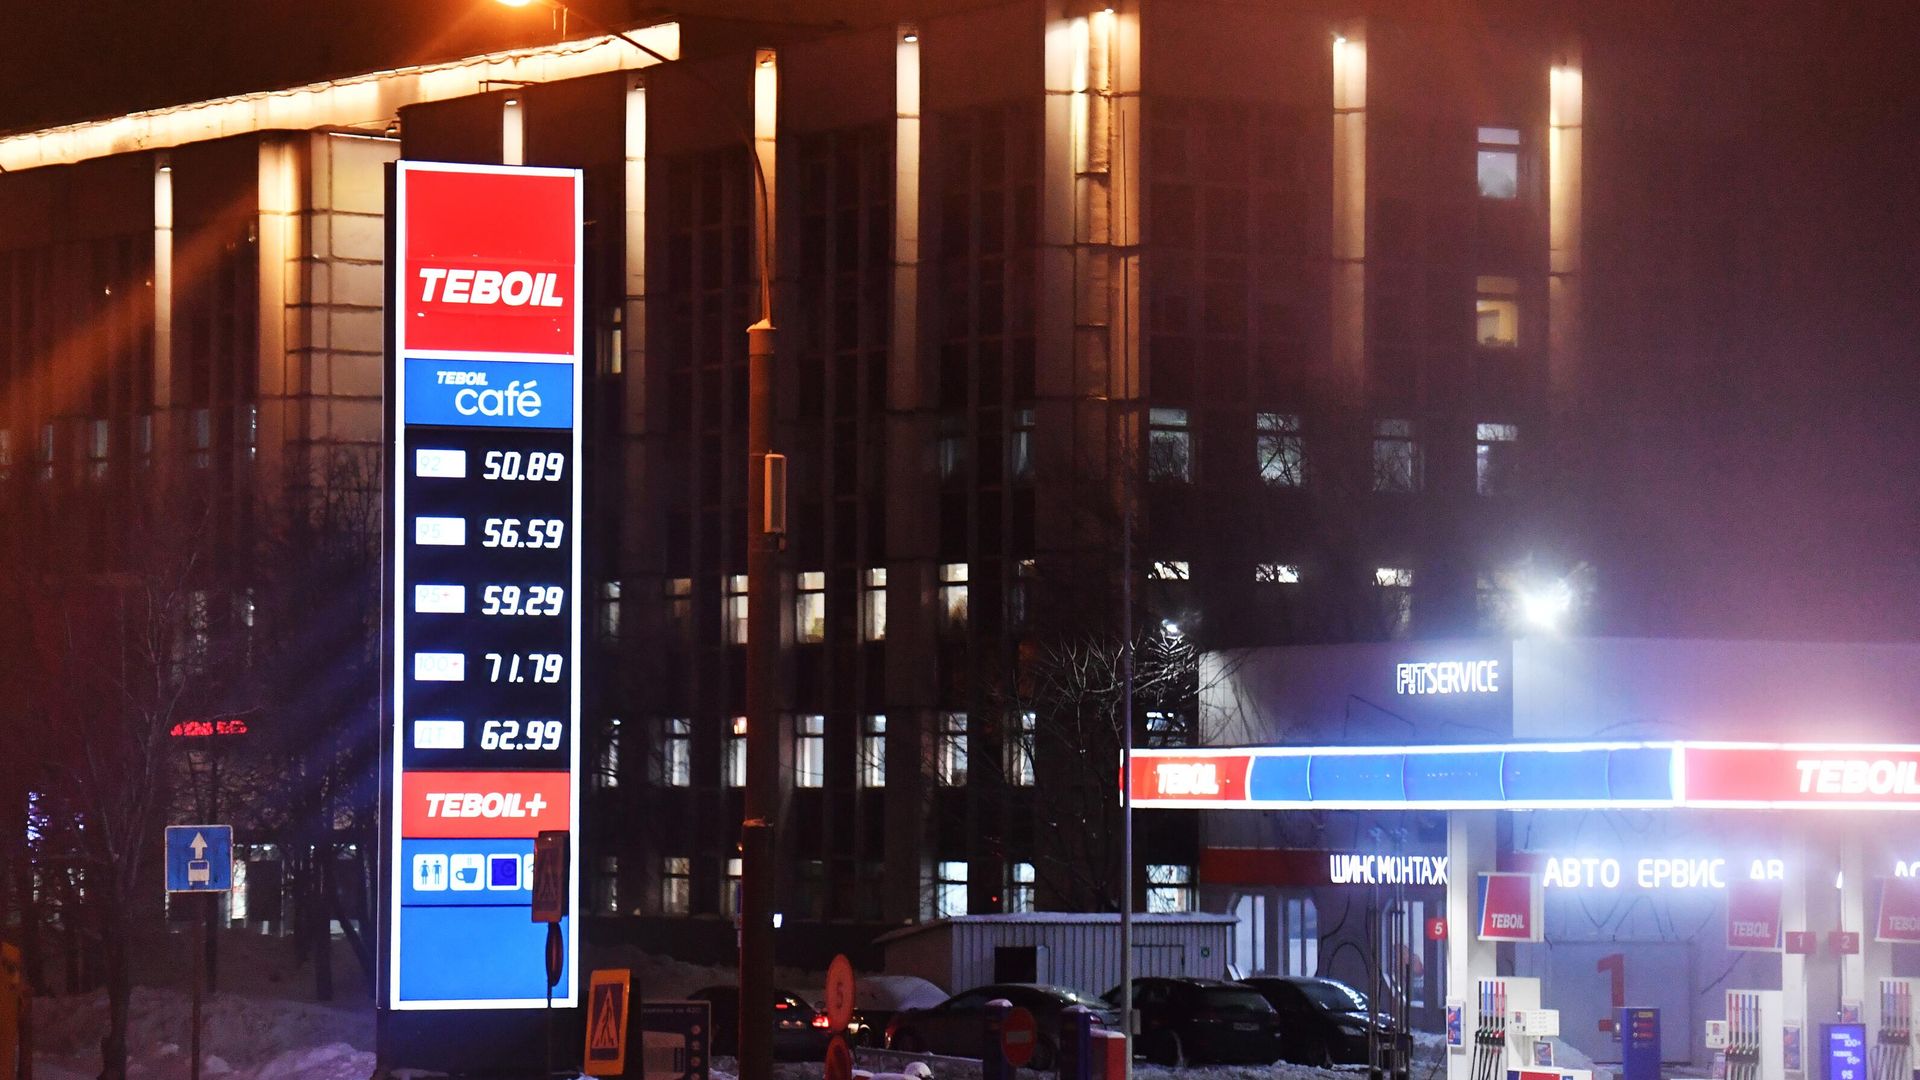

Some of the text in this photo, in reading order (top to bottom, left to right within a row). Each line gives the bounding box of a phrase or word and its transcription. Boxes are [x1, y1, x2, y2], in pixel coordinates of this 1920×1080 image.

[419, 267, 563, 307] TEBOIL
[436, 370, 489, 386] TEBOIL
[454, 379, 542, 418] café
[482, 450, 565, 482] 50.89
[482, 518, 565, 549] 56.59
[481, 585, 564, 616] 59.29
[485, 653, 563, 684] 71.79
[480, 720, 563, 751] 62.99
[1796, 759, 1920, 795] TEBOIL
[425, 791, 548, 819] TEBOIL+
[1434, 922, 1444, 935] 5
[1491, 913, 1524, 929] TEBOIL
